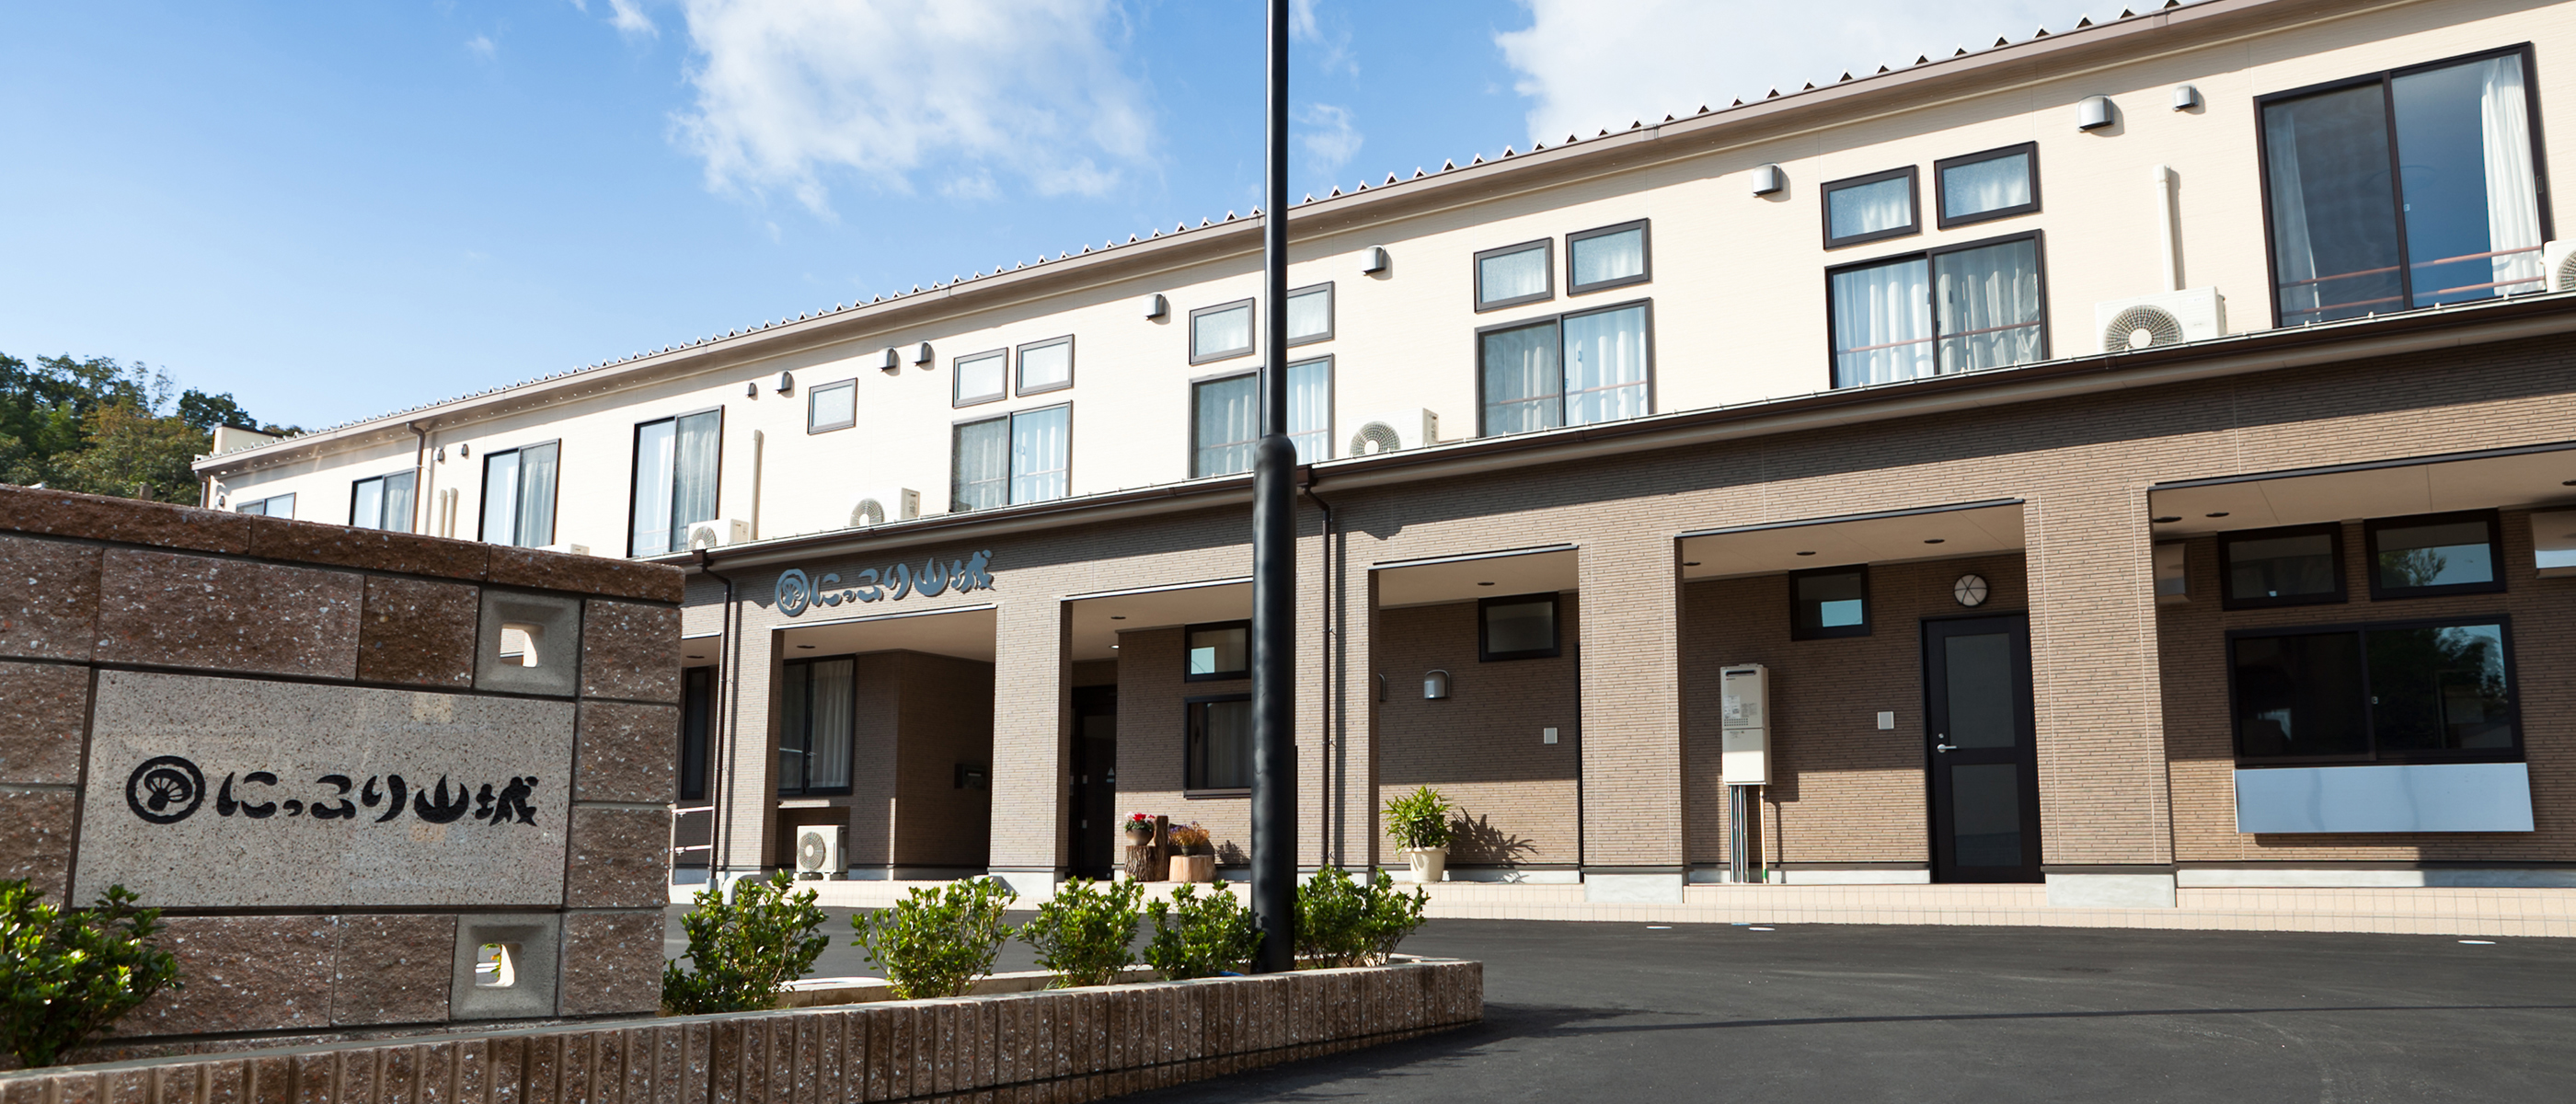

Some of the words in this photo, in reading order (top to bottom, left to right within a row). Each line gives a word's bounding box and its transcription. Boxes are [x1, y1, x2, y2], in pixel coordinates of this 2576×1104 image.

[811, 549, 995, 607] にっこり山城
[215, 771, 540, 827] にっこり山城
